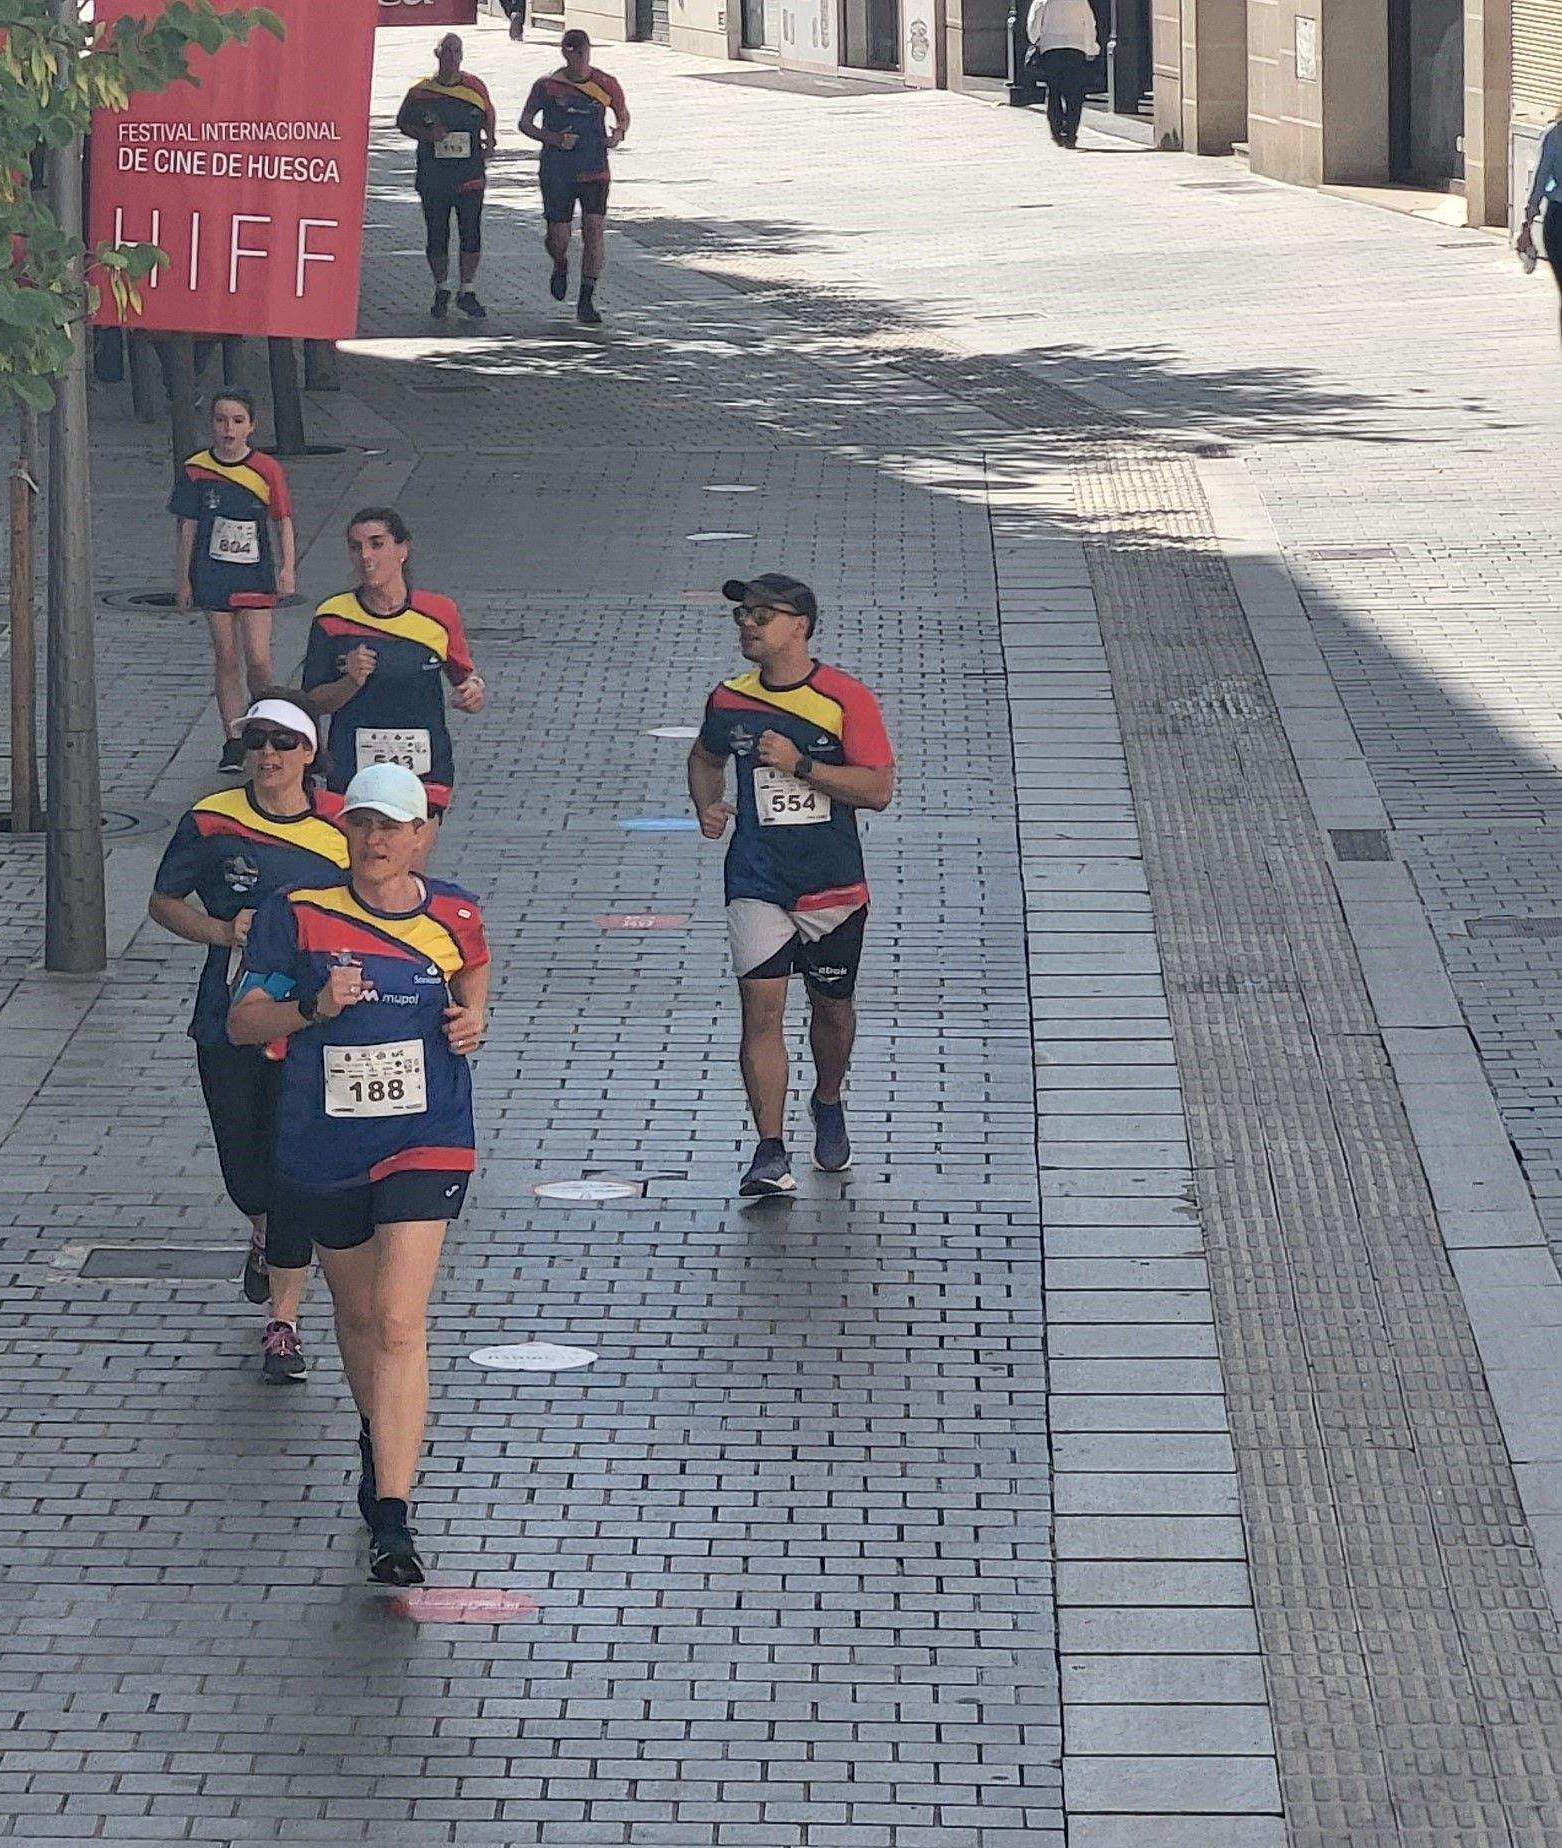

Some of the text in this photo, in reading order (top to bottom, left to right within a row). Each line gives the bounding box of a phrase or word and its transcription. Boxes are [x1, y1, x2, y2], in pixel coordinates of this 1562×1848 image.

[118, 121, 341, 143] FESTIVAL INTERNACIONAL
[118, 147, 340, 184] DE CINE DE HUESCA
[114, 206, 339, 298] HIFF
[771, 793, 816, 813] 554
[381, 992, 420, 1006] mupol
[348, 1078, 405, 1103] 188
